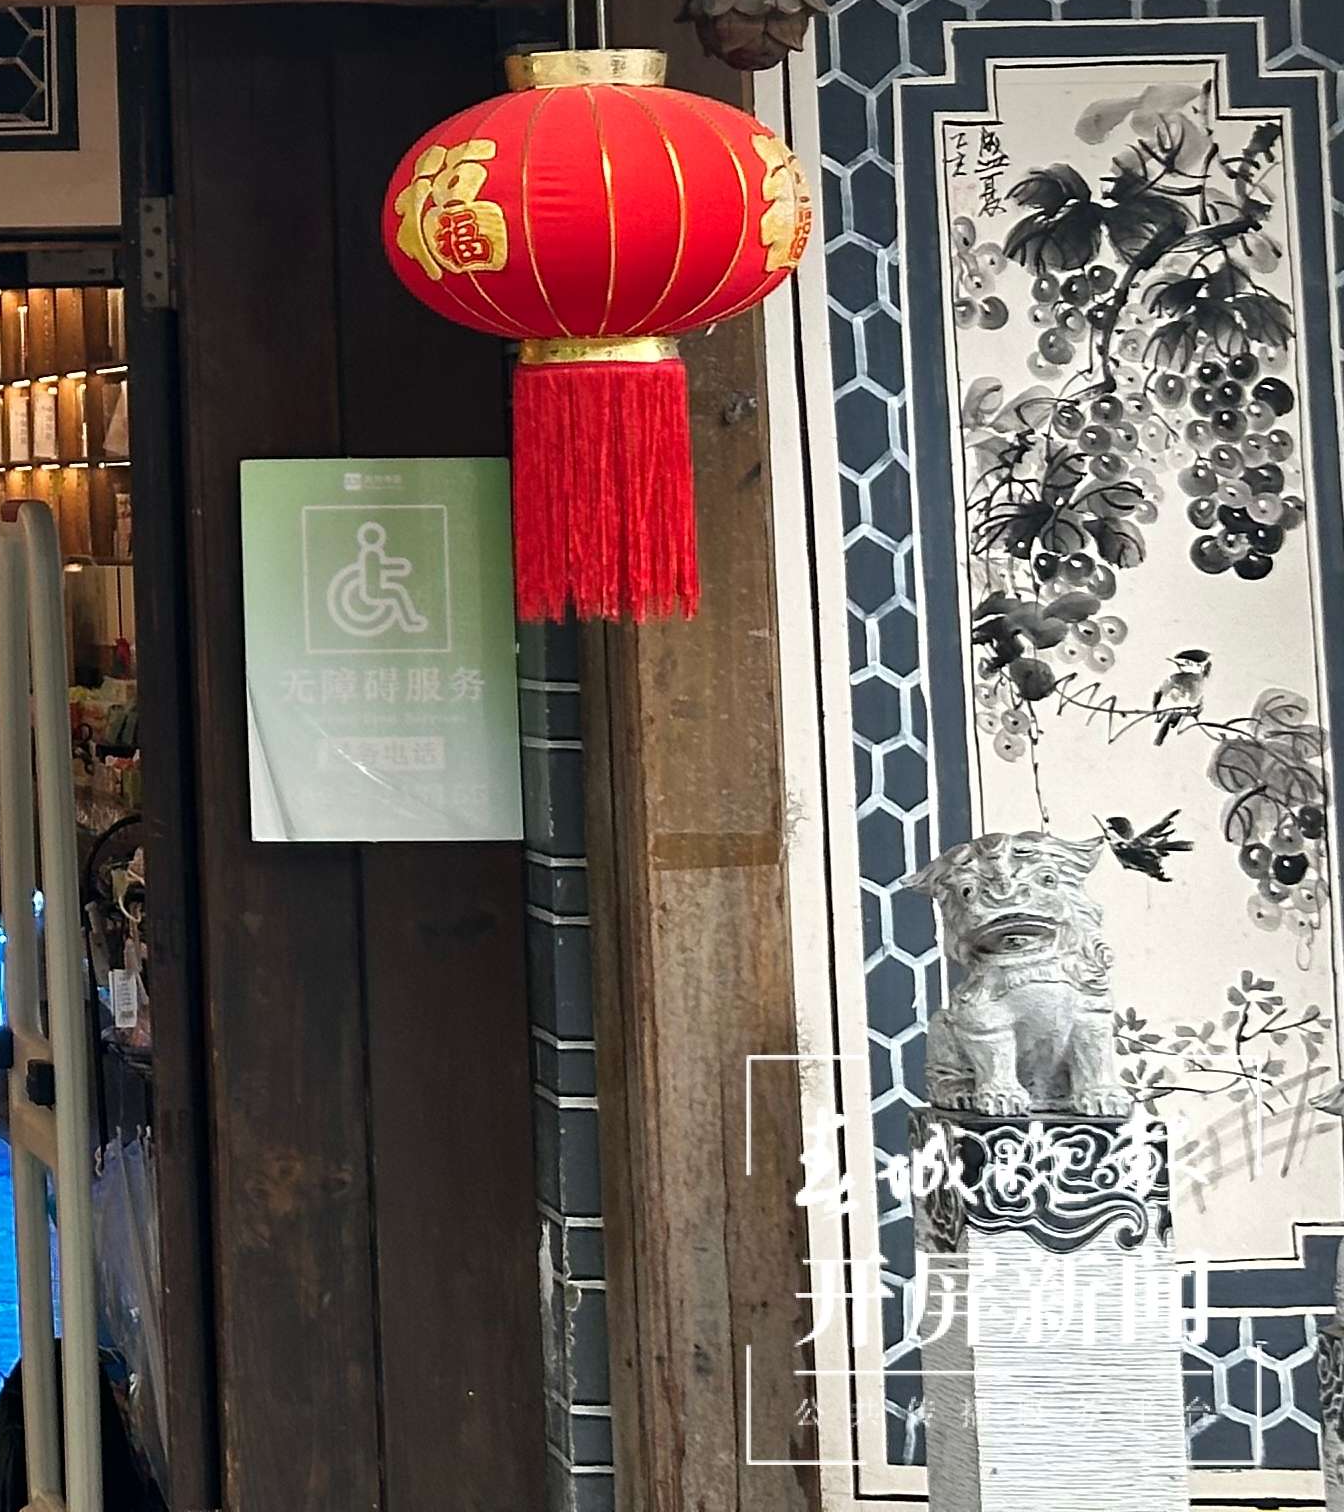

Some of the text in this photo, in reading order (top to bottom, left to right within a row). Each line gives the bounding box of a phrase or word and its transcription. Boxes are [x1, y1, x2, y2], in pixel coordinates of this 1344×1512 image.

[280, 666, 486, 706] 无障碍服务
